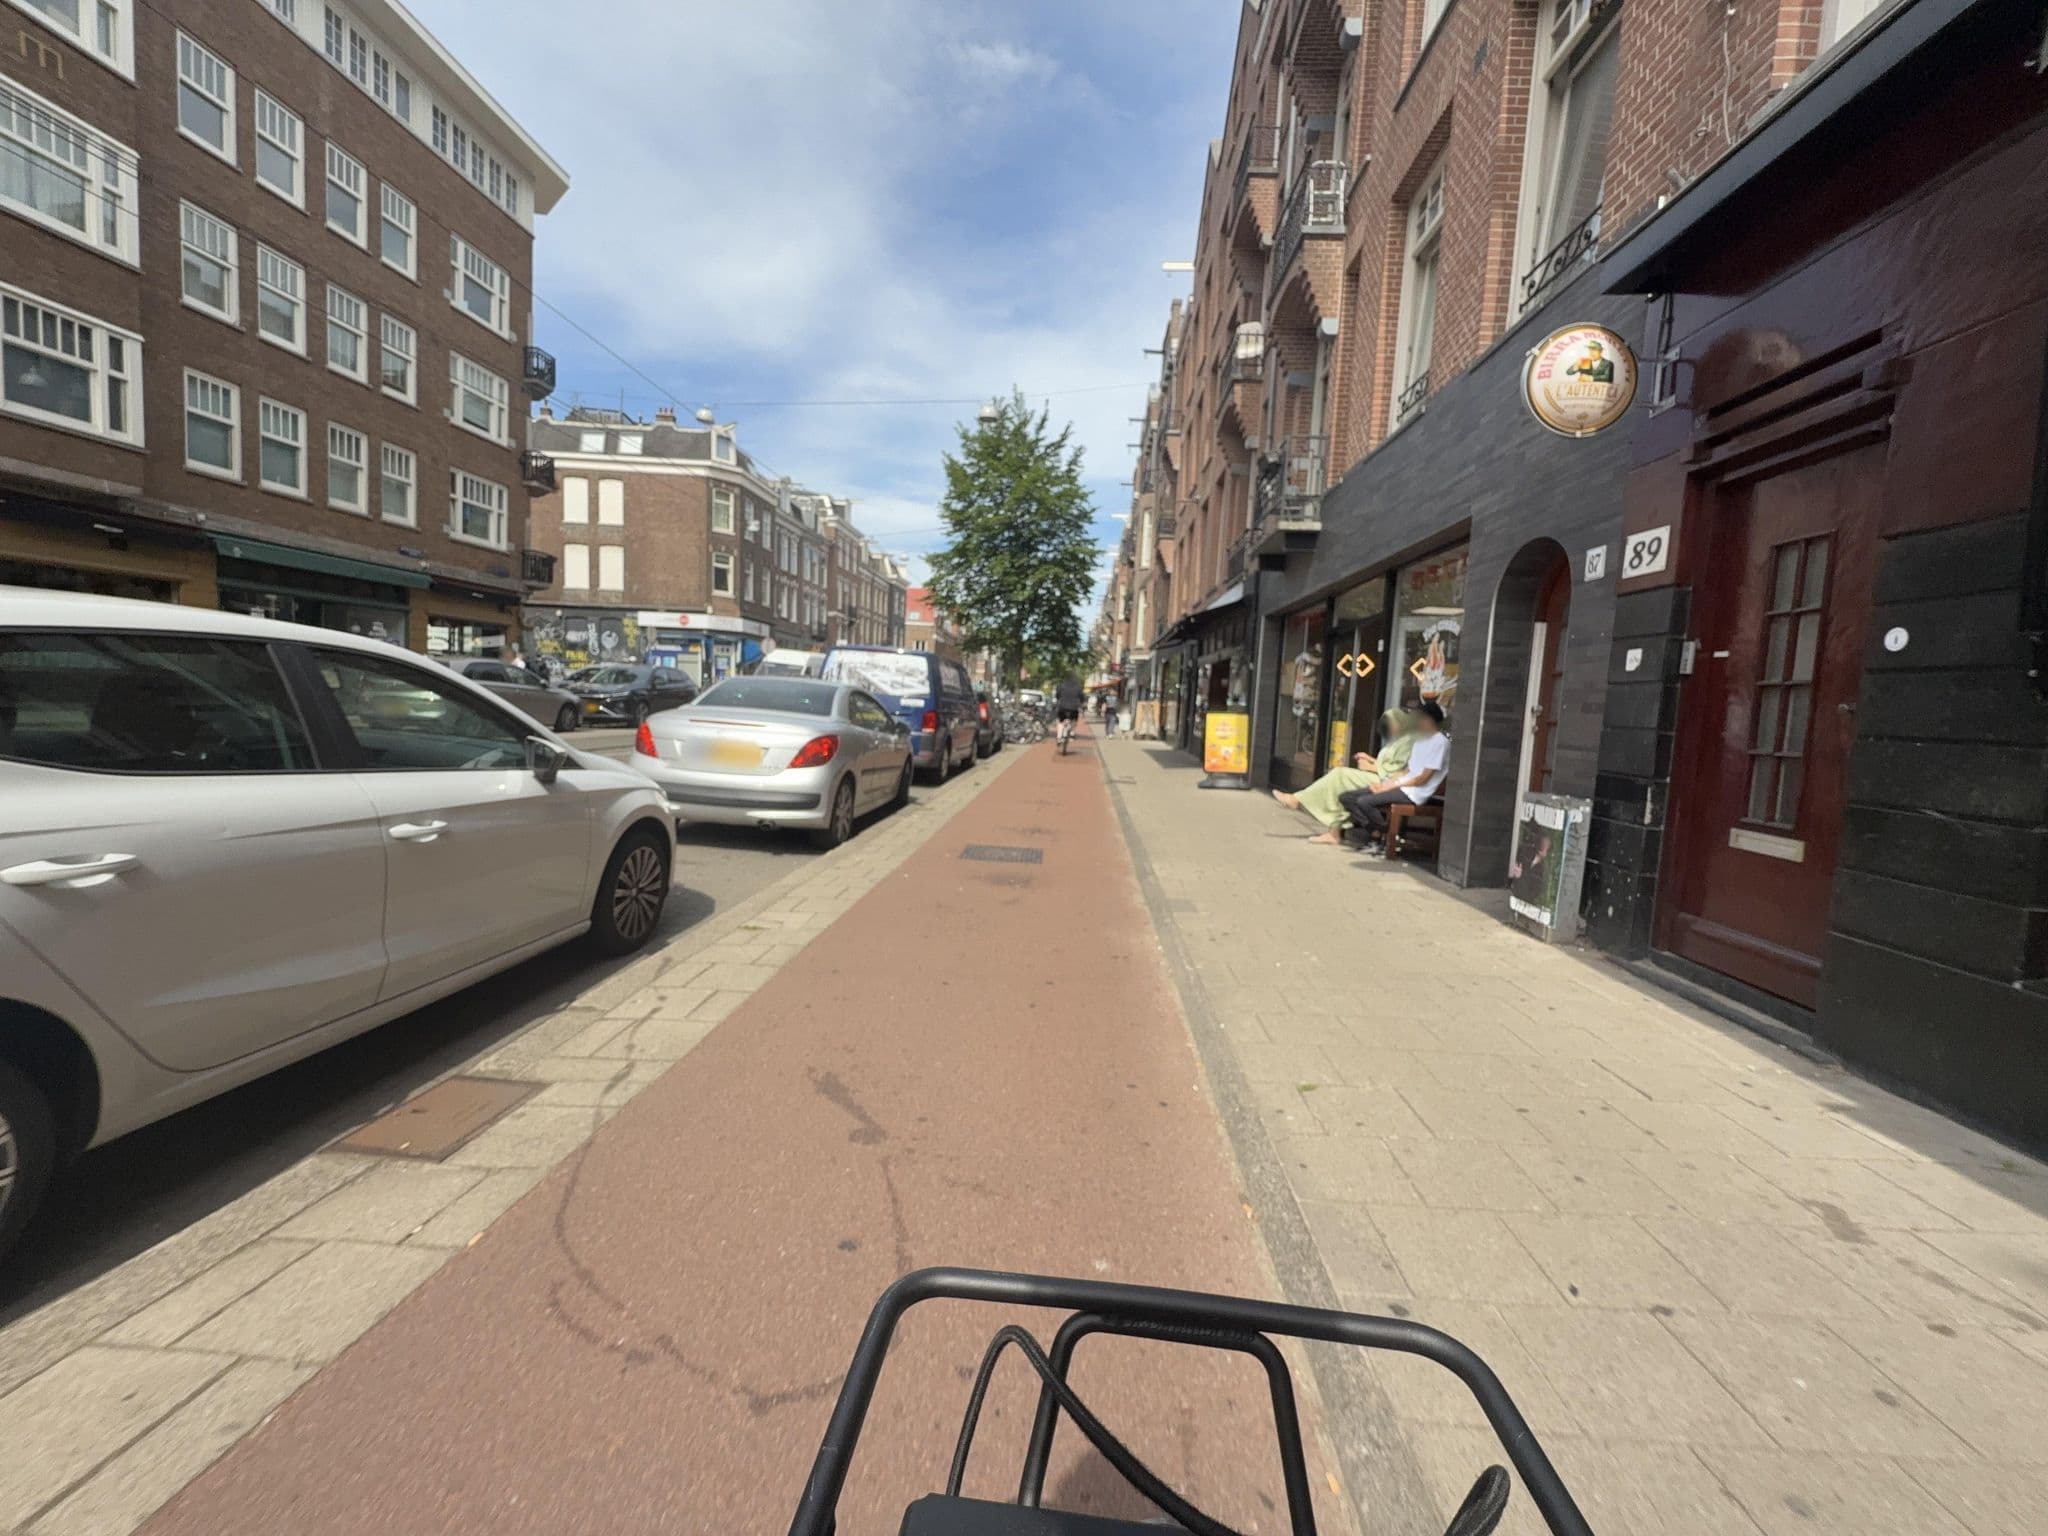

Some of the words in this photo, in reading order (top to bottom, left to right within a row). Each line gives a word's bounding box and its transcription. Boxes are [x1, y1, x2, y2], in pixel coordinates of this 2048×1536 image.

[1537, 334, 1581, 381] BIRRA
[1588, 553, 1601, 574] 87
[1628, 535, 1662, 570] 89
